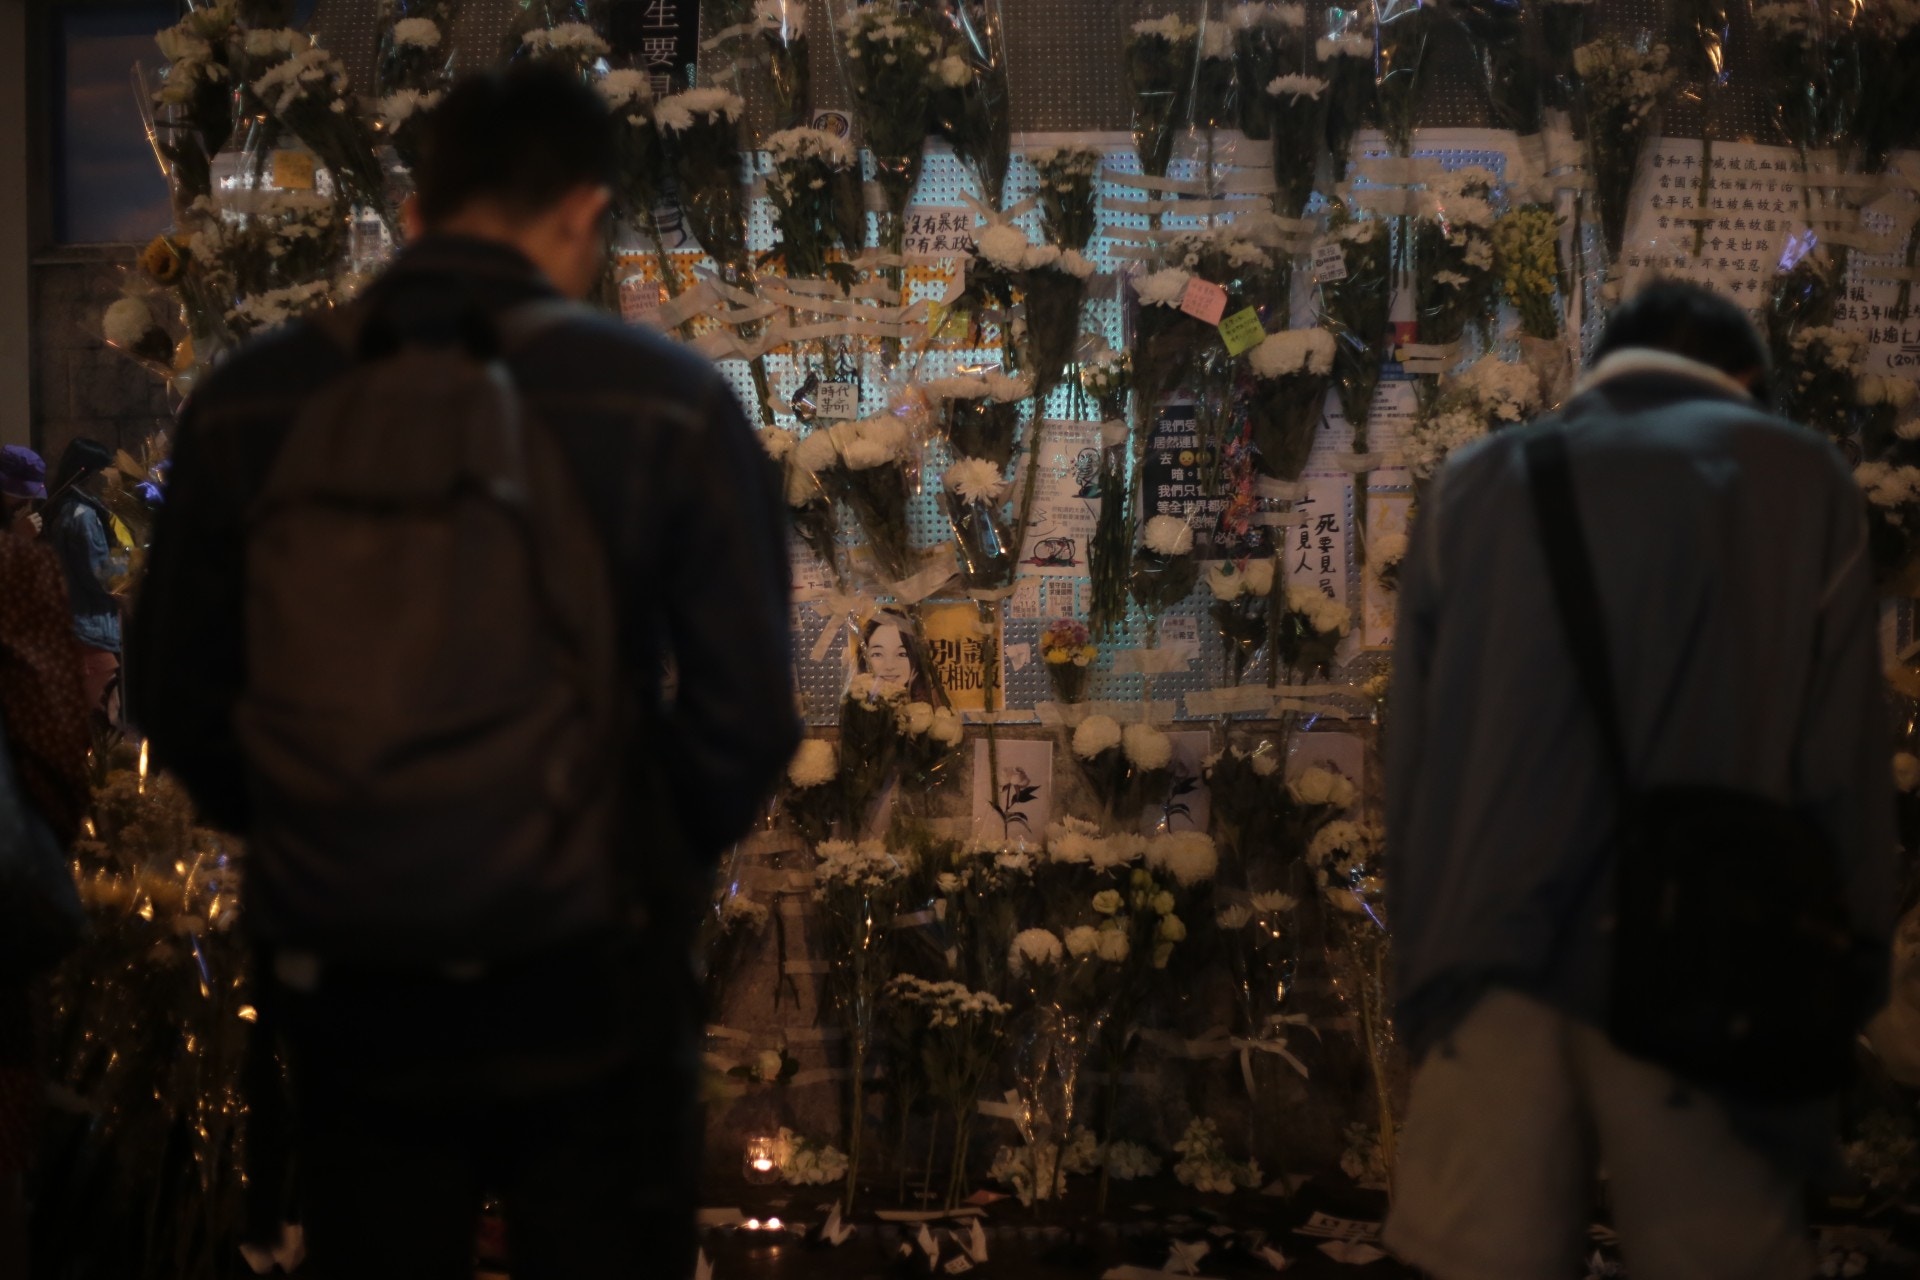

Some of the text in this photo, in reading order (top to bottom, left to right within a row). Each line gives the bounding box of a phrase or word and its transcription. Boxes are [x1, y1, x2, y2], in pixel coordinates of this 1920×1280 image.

[1650, 193, 1800, 213] 當平民性被無故定罪
[903, 212, 970, 235] 沒有暴徒
[904, 235, 973, 254] 只有暴政
[1680, 236, 1769, 252] 革會是出路
[821, 385, 850, 398] 時代
[821, 398, 850, 414] 革命
[1160, 452, 1173, 468] 去
